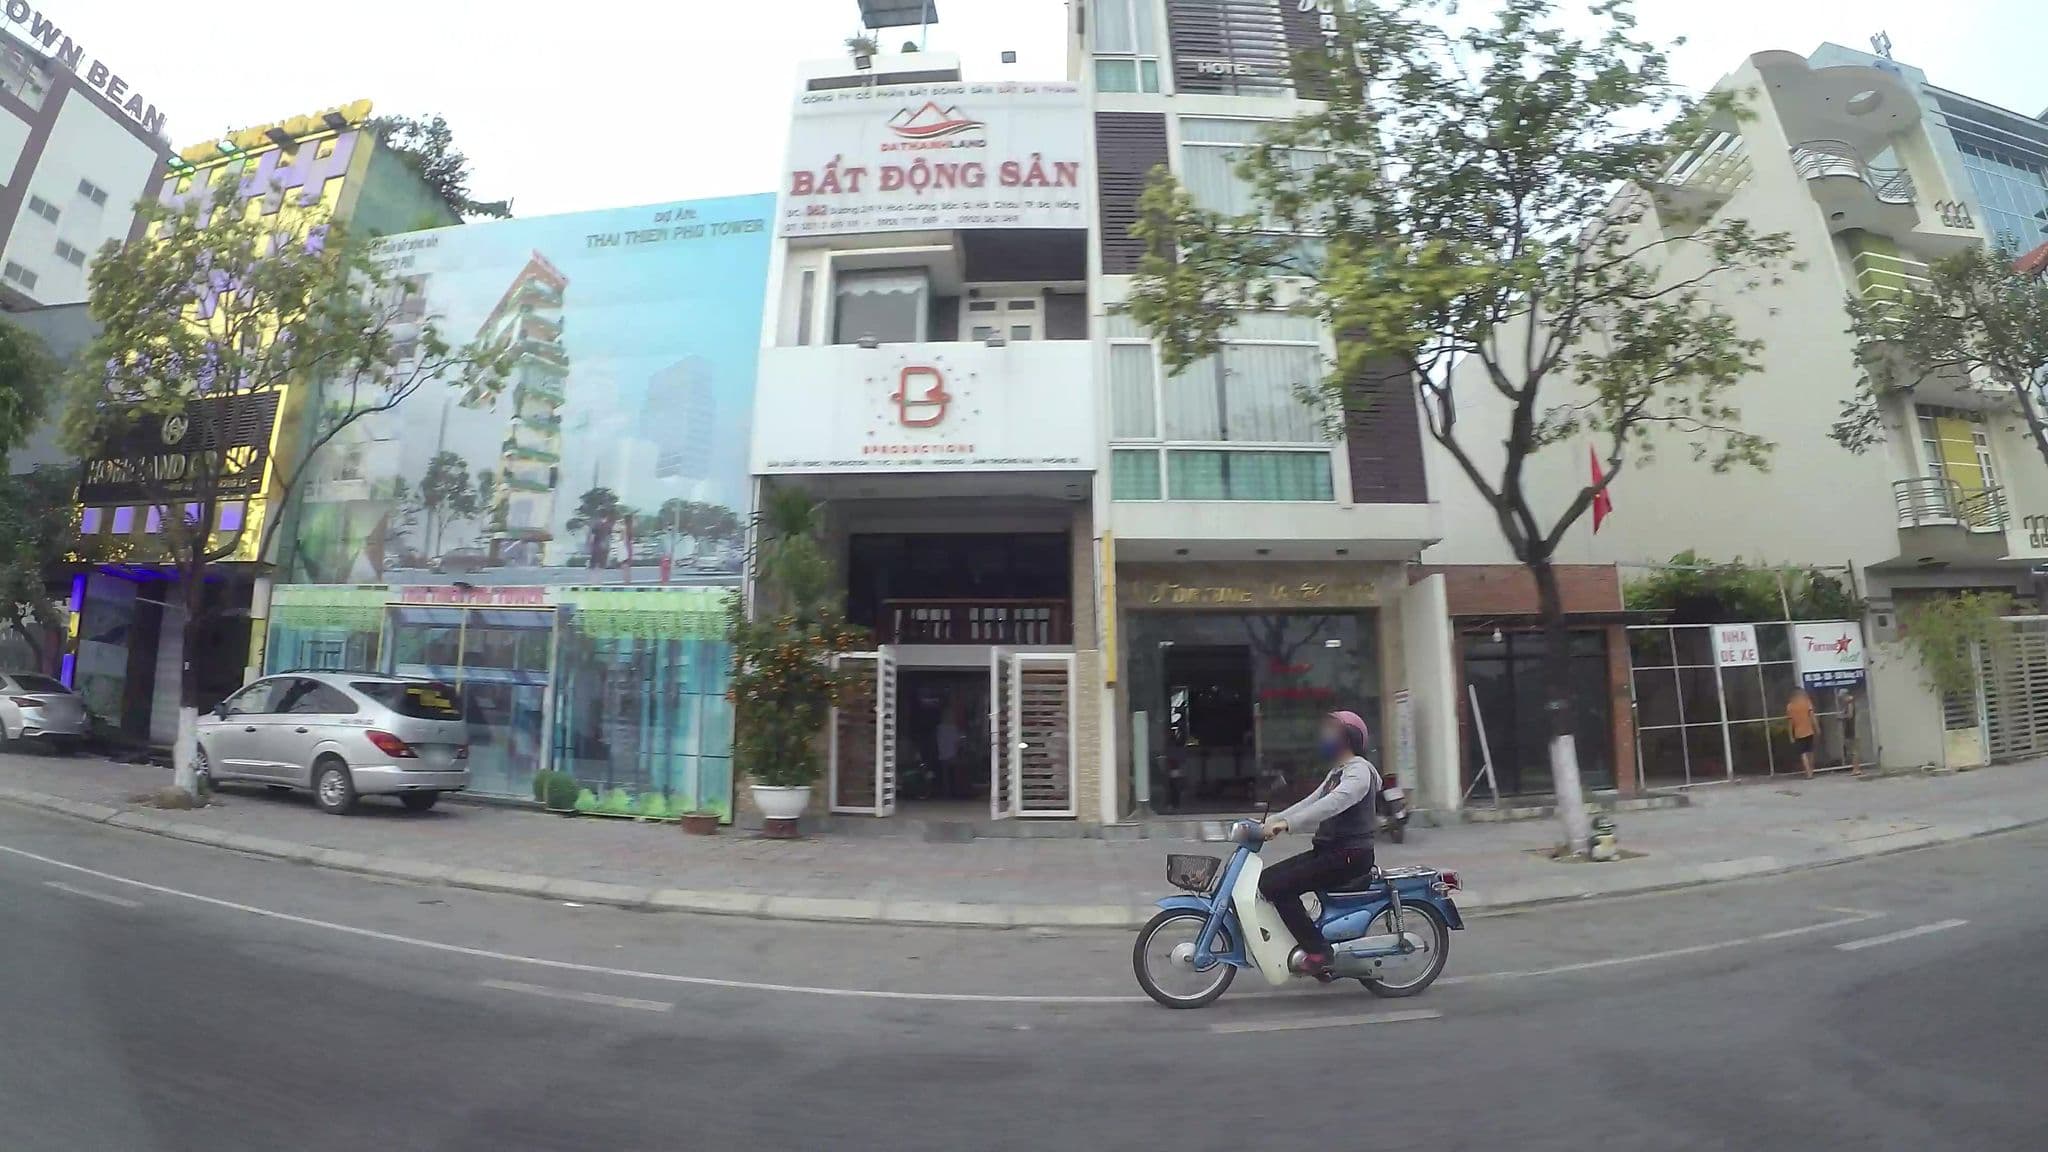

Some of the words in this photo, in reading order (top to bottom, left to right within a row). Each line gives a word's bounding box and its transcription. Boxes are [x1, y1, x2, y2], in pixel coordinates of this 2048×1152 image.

[1198, 62, 1259, 74] HOTEL
[87, 60, 166, 135] BEAN
[789, 153, 867, 196] BẤT
[878, 156, 986, 195] ĐỘNG
[999, 152, 1080, 188] SẢN
[709, 218, 766, 237] TOWER
